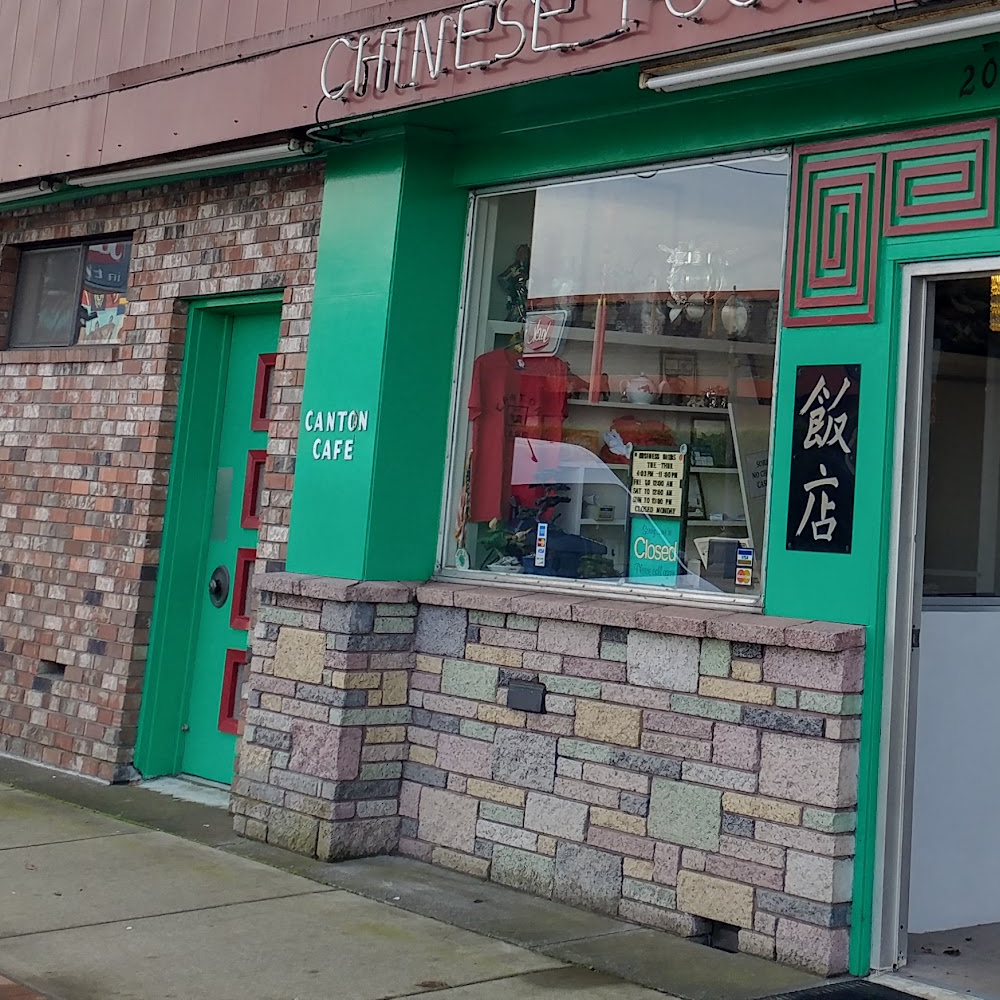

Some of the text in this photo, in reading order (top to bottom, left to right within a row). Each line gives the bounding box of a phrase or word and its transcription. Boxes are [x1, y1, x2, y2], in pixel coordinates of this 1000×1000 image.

[304, 410, 369, 432] CANTON
[312, 438, 354, 460] CAFE
[796, 375, 851, 541] 飯店
[634, 536, 678, 562] Closed
